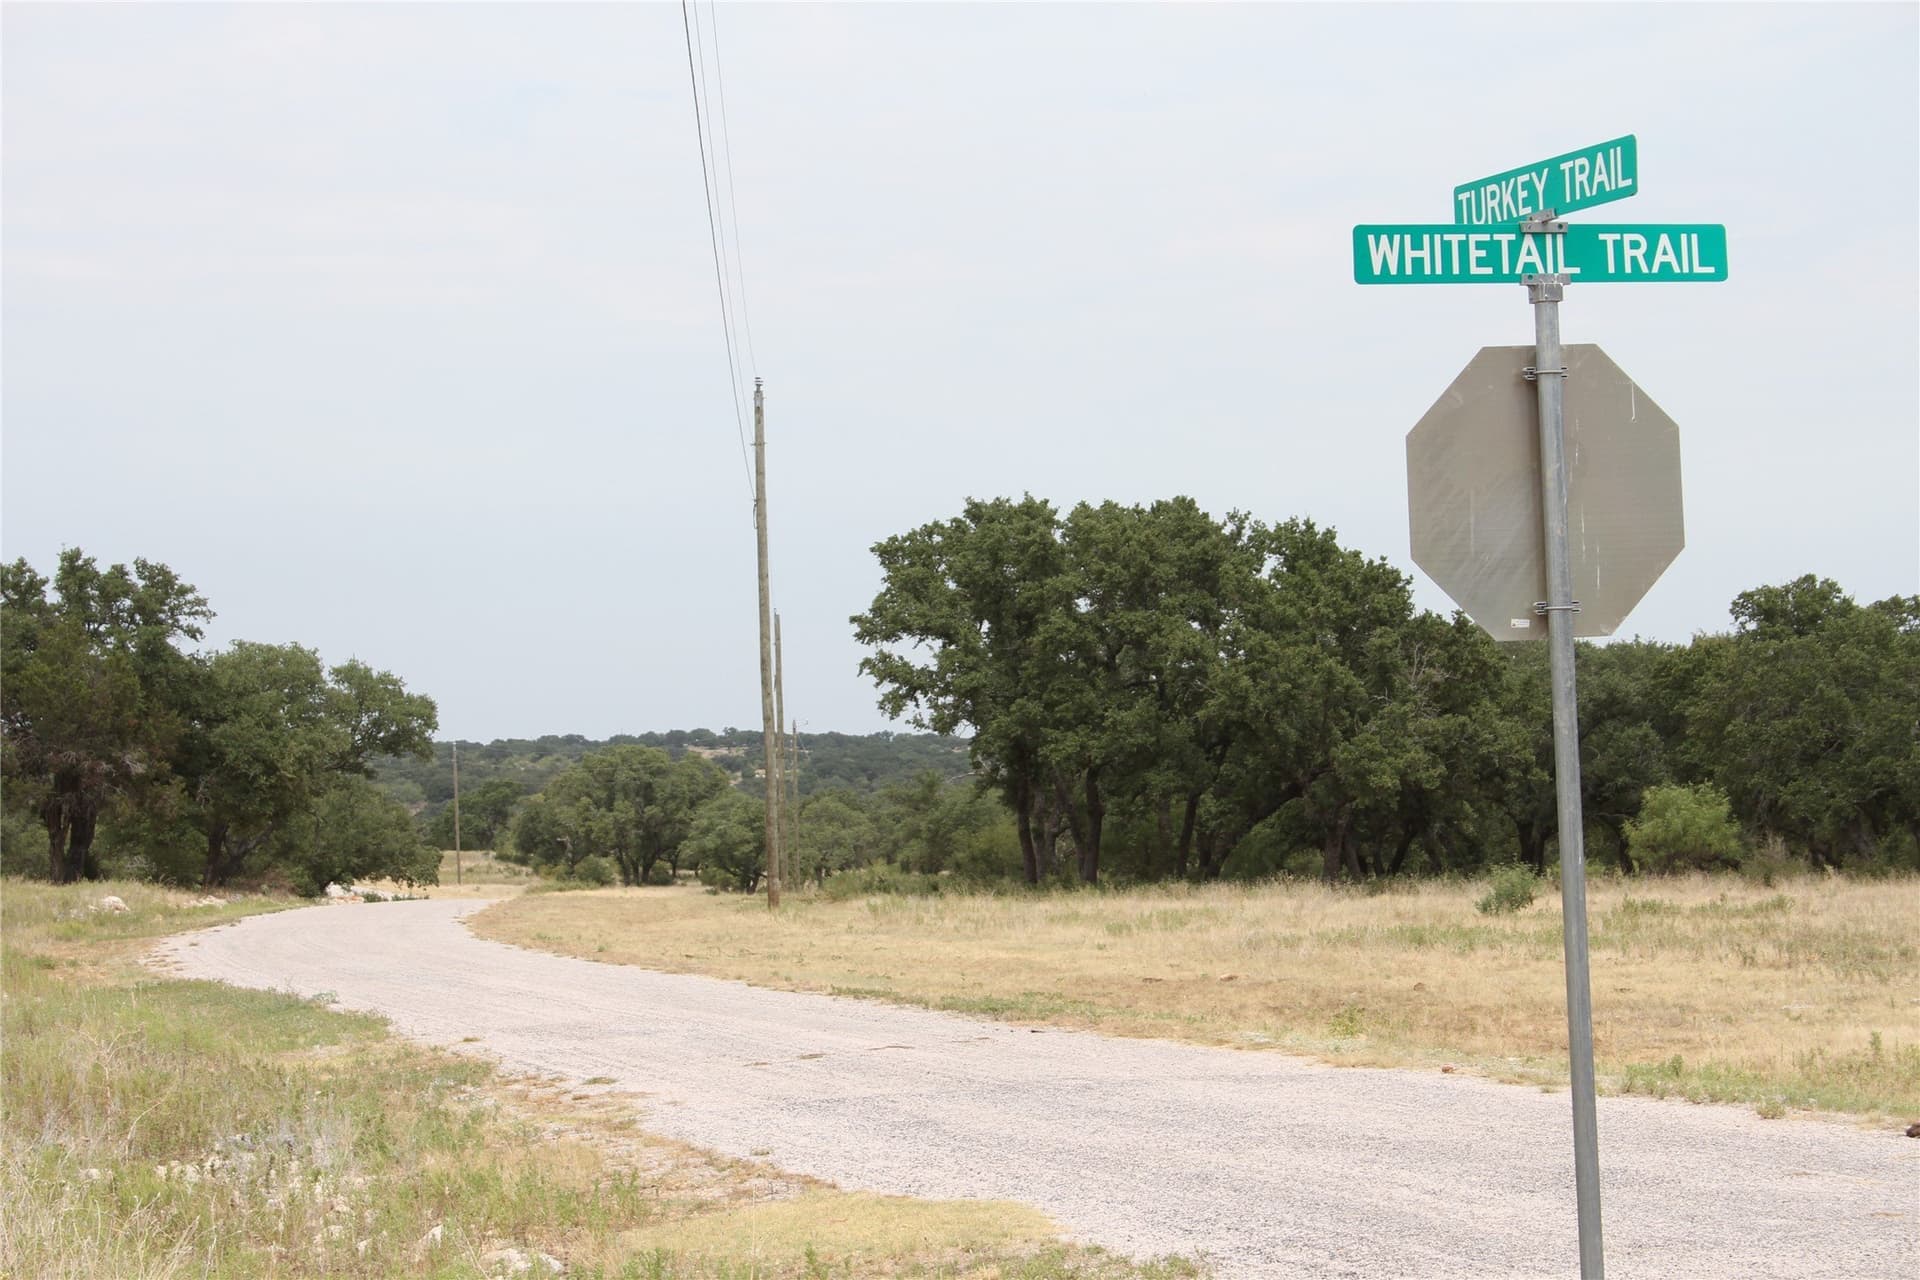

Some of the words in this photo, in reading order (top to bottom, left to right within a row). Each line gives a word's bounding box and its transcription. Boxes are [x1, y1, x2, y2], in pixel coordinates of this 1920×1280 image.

[1458, 167, 1549, 224] TURKEY
[1559, 146, 1632, 203] TRAIL
[1367, 233, 1580, 275] WHITETAIL
[1598, 233, 1715, 274] TRAIL
